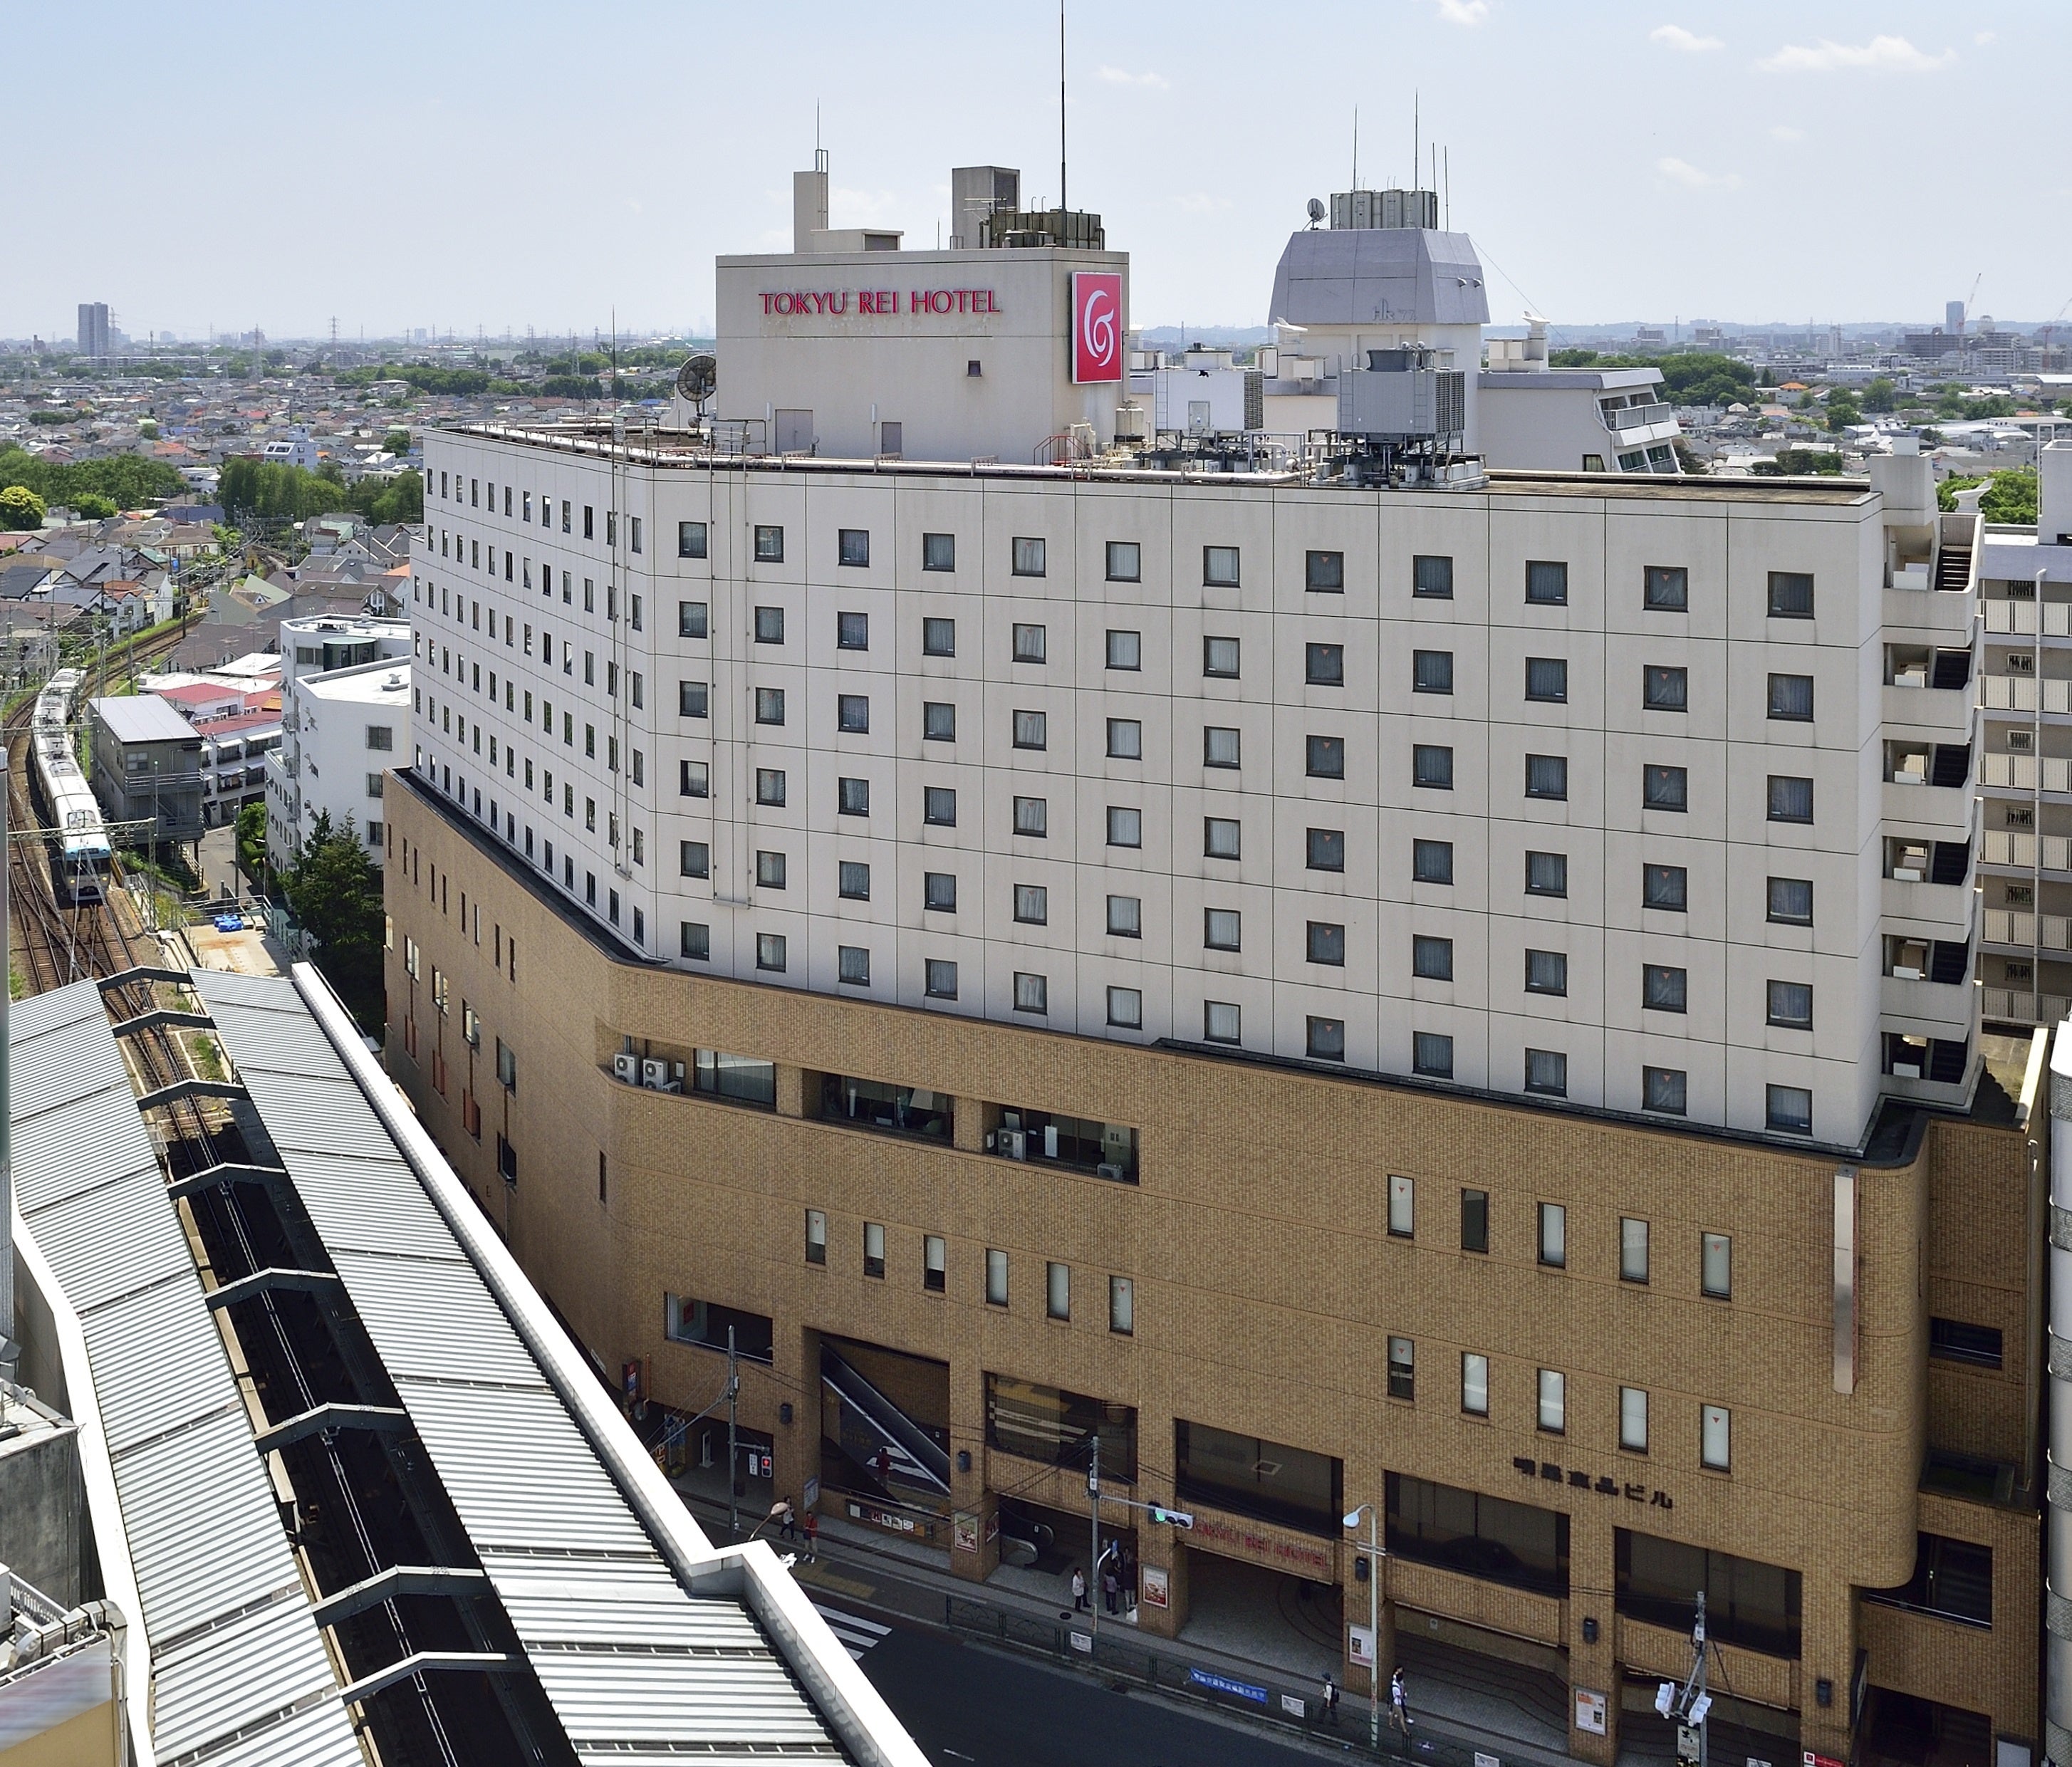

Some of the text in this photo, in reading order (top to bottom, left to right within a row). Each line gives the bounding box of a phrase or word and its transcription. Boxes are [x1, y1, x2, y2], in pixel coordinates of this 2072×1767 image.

[758, 289, 1001, 315] TOKYU REI HOTEL
[1192, 1520, 1237, 1543] OKYU
